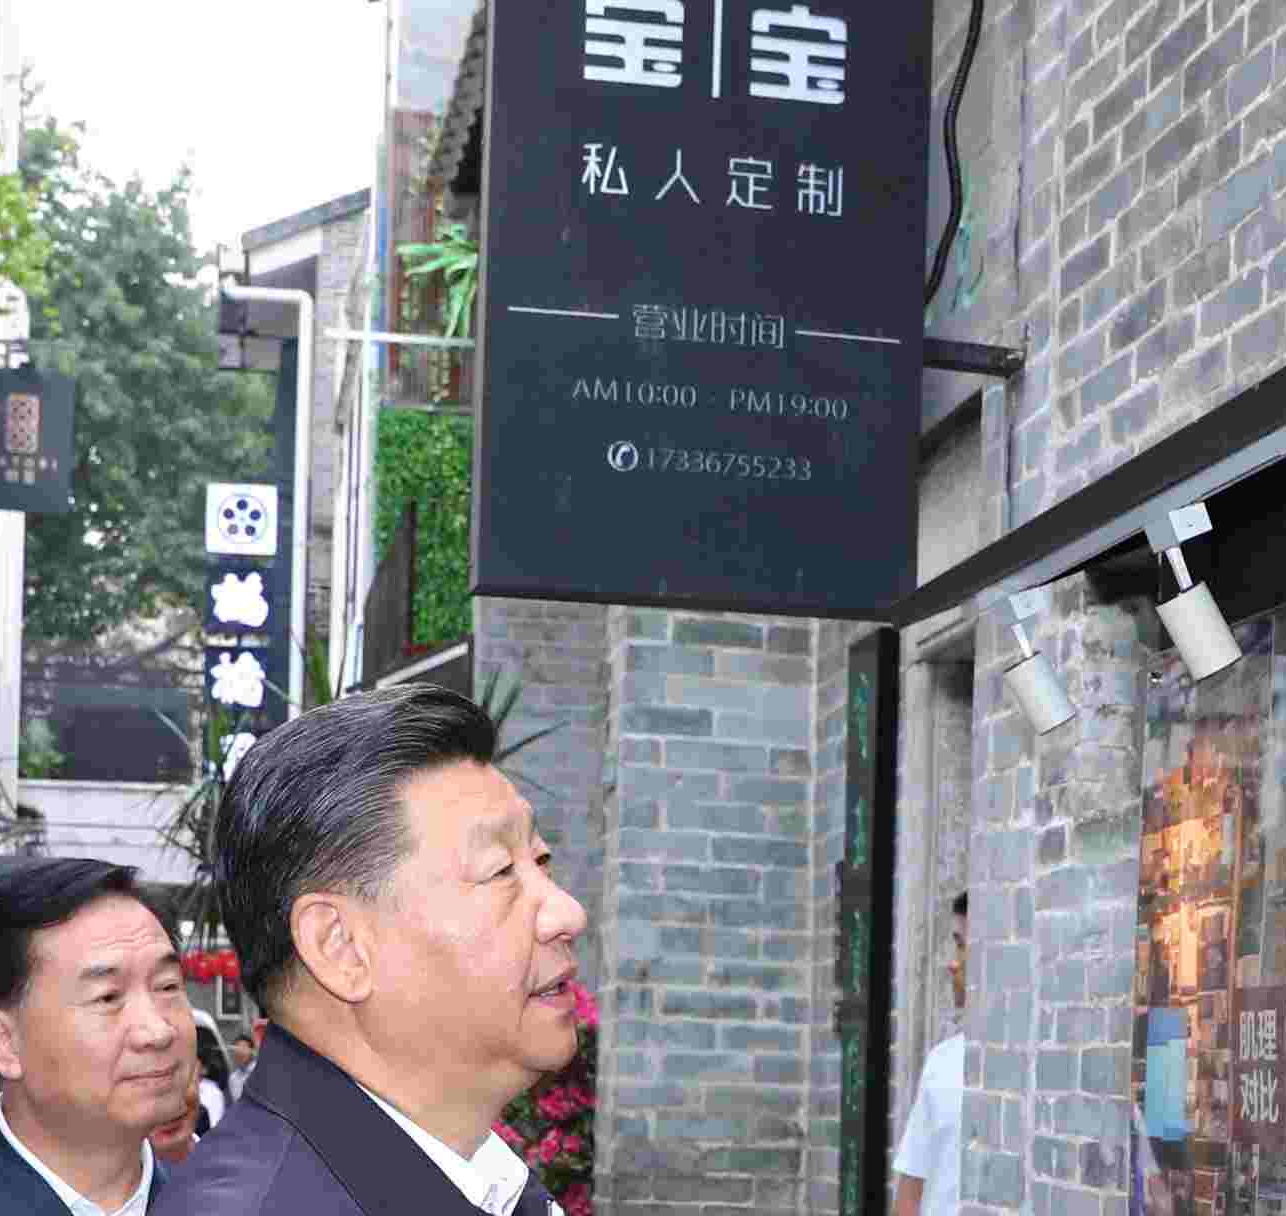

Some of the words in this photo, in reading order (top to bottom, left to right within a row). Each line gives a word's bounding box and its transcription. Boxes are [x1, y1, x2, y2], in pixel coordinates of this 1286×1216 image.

[581, 142, 844, 217] 私人定制
[632, 303, 786, 350] 营业时间
[572, 376, 698, 409] AM10:00
[729, 387, 848, 422] PM19:00
[647, 446, 813, 482] 17336755233
[1239, 1009, 1277, 1062] 肌理
[1239, 1068, 1279, 1123] 对比
